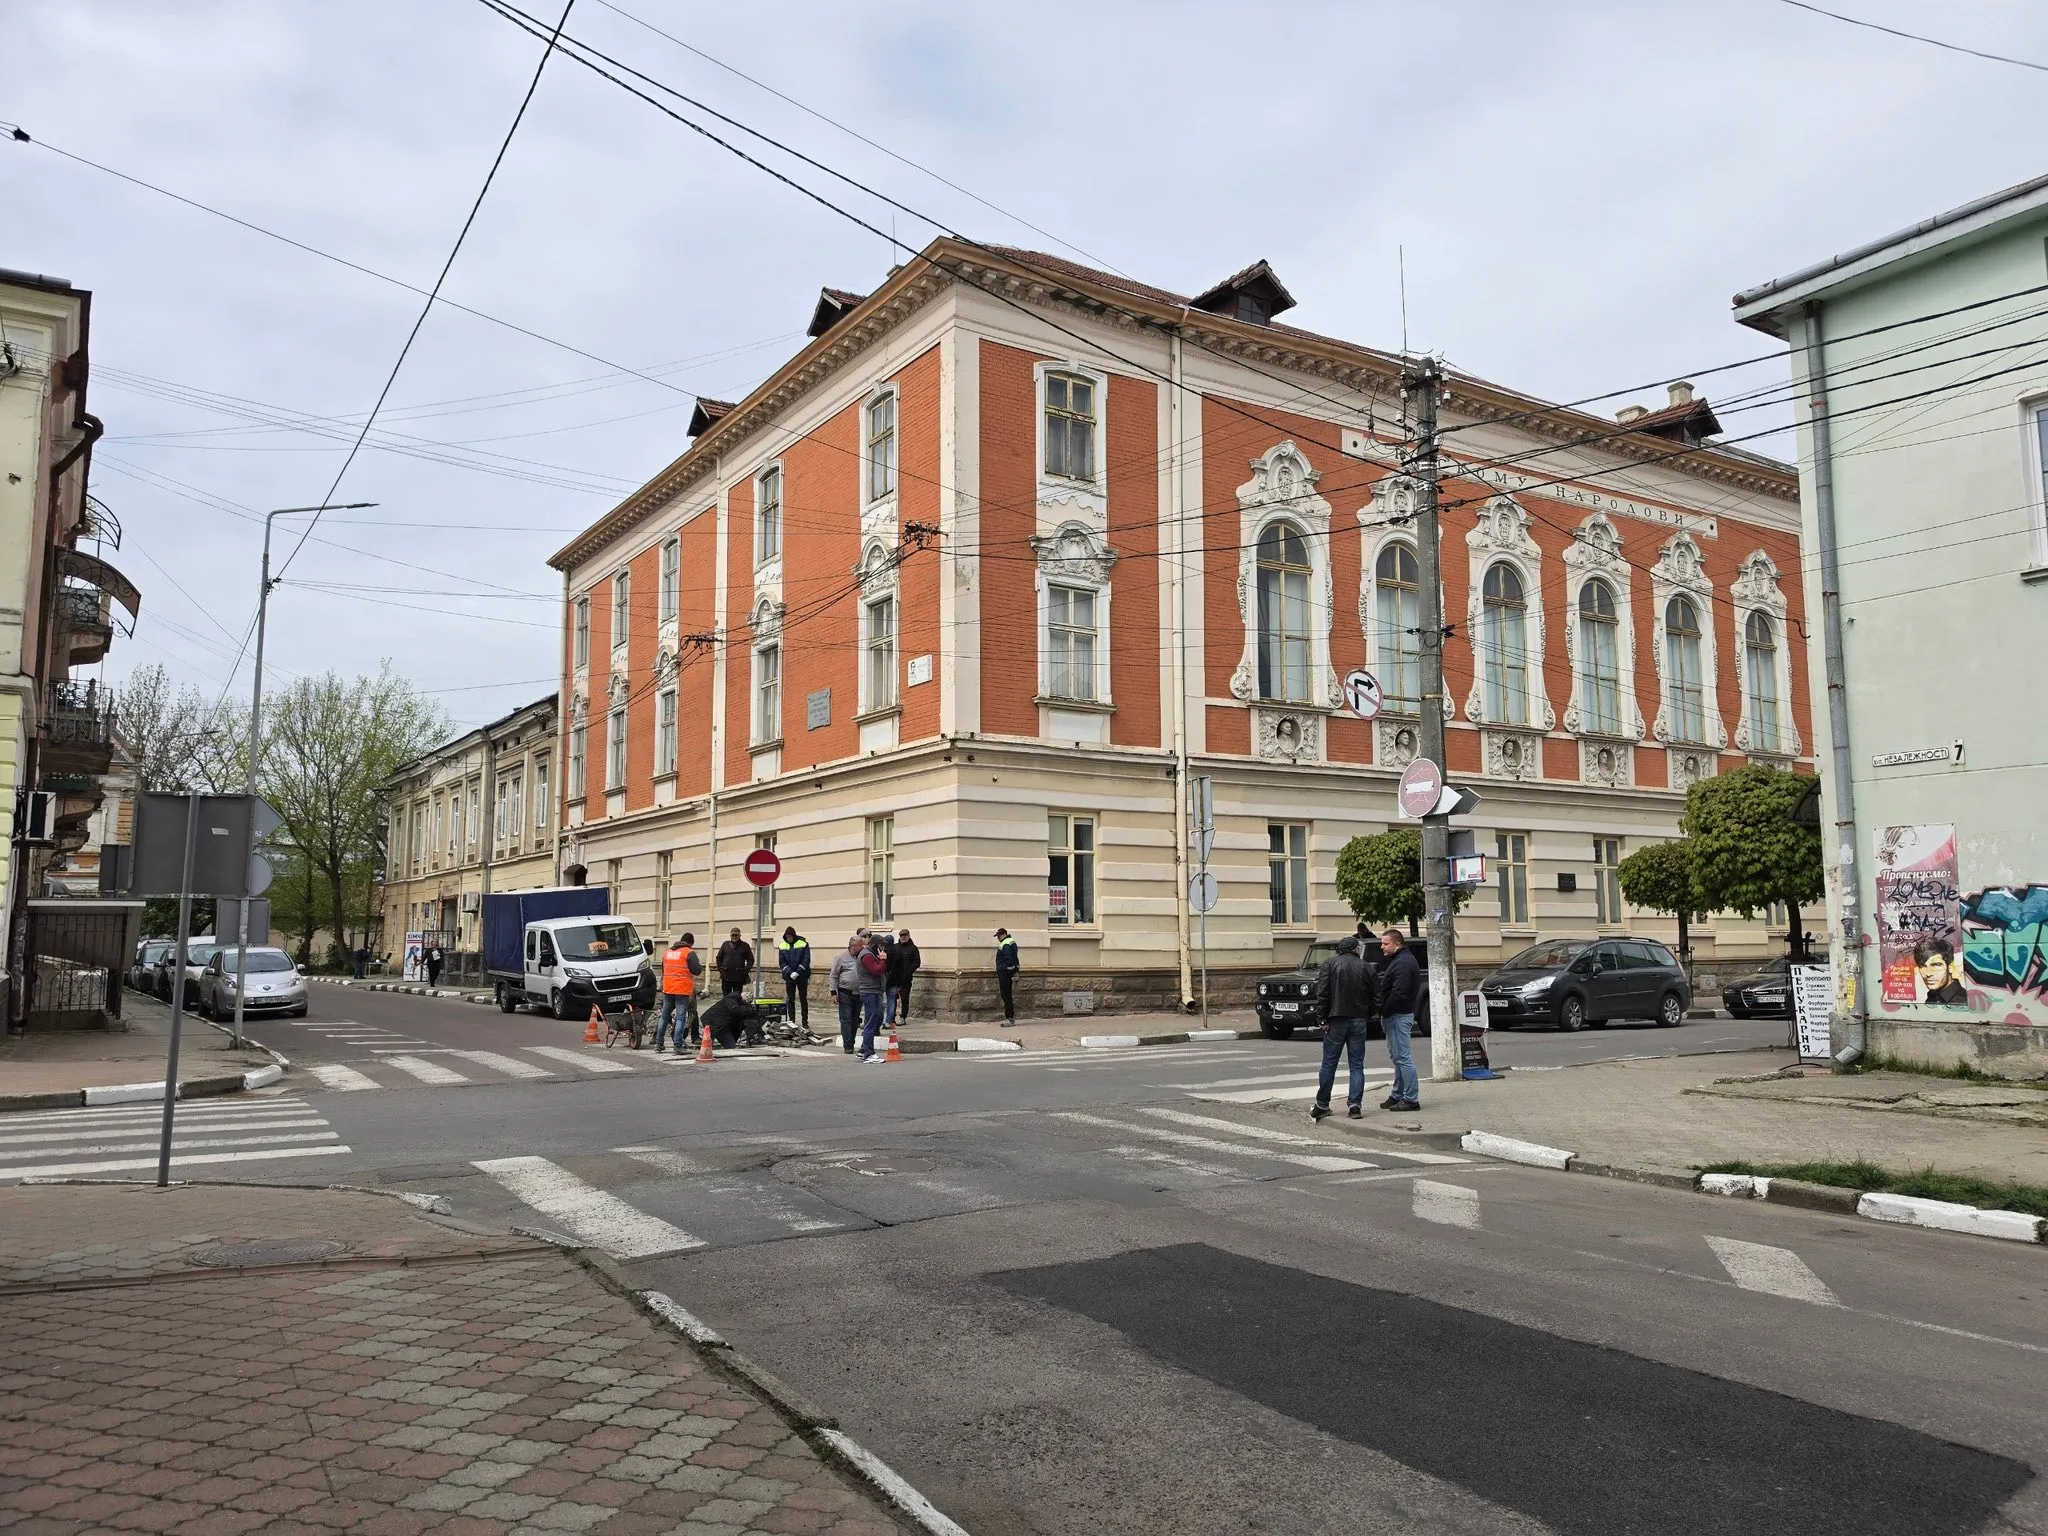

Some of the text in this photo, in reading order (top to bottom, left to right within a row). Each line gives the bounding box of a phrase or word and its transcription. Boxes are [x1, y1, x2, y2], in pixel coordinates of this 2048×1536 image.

[1555, 485, 1684, 525] НАРОДОВИ
[1884, 749, 1947, 763] НЕЗАЛЕЖНОСТІ
[1954, 744, 1963, 760] 7
[932, 860, 938, 870] 5
[1793, 967, 1811, 1053] ПЕРУКАРНЯ
